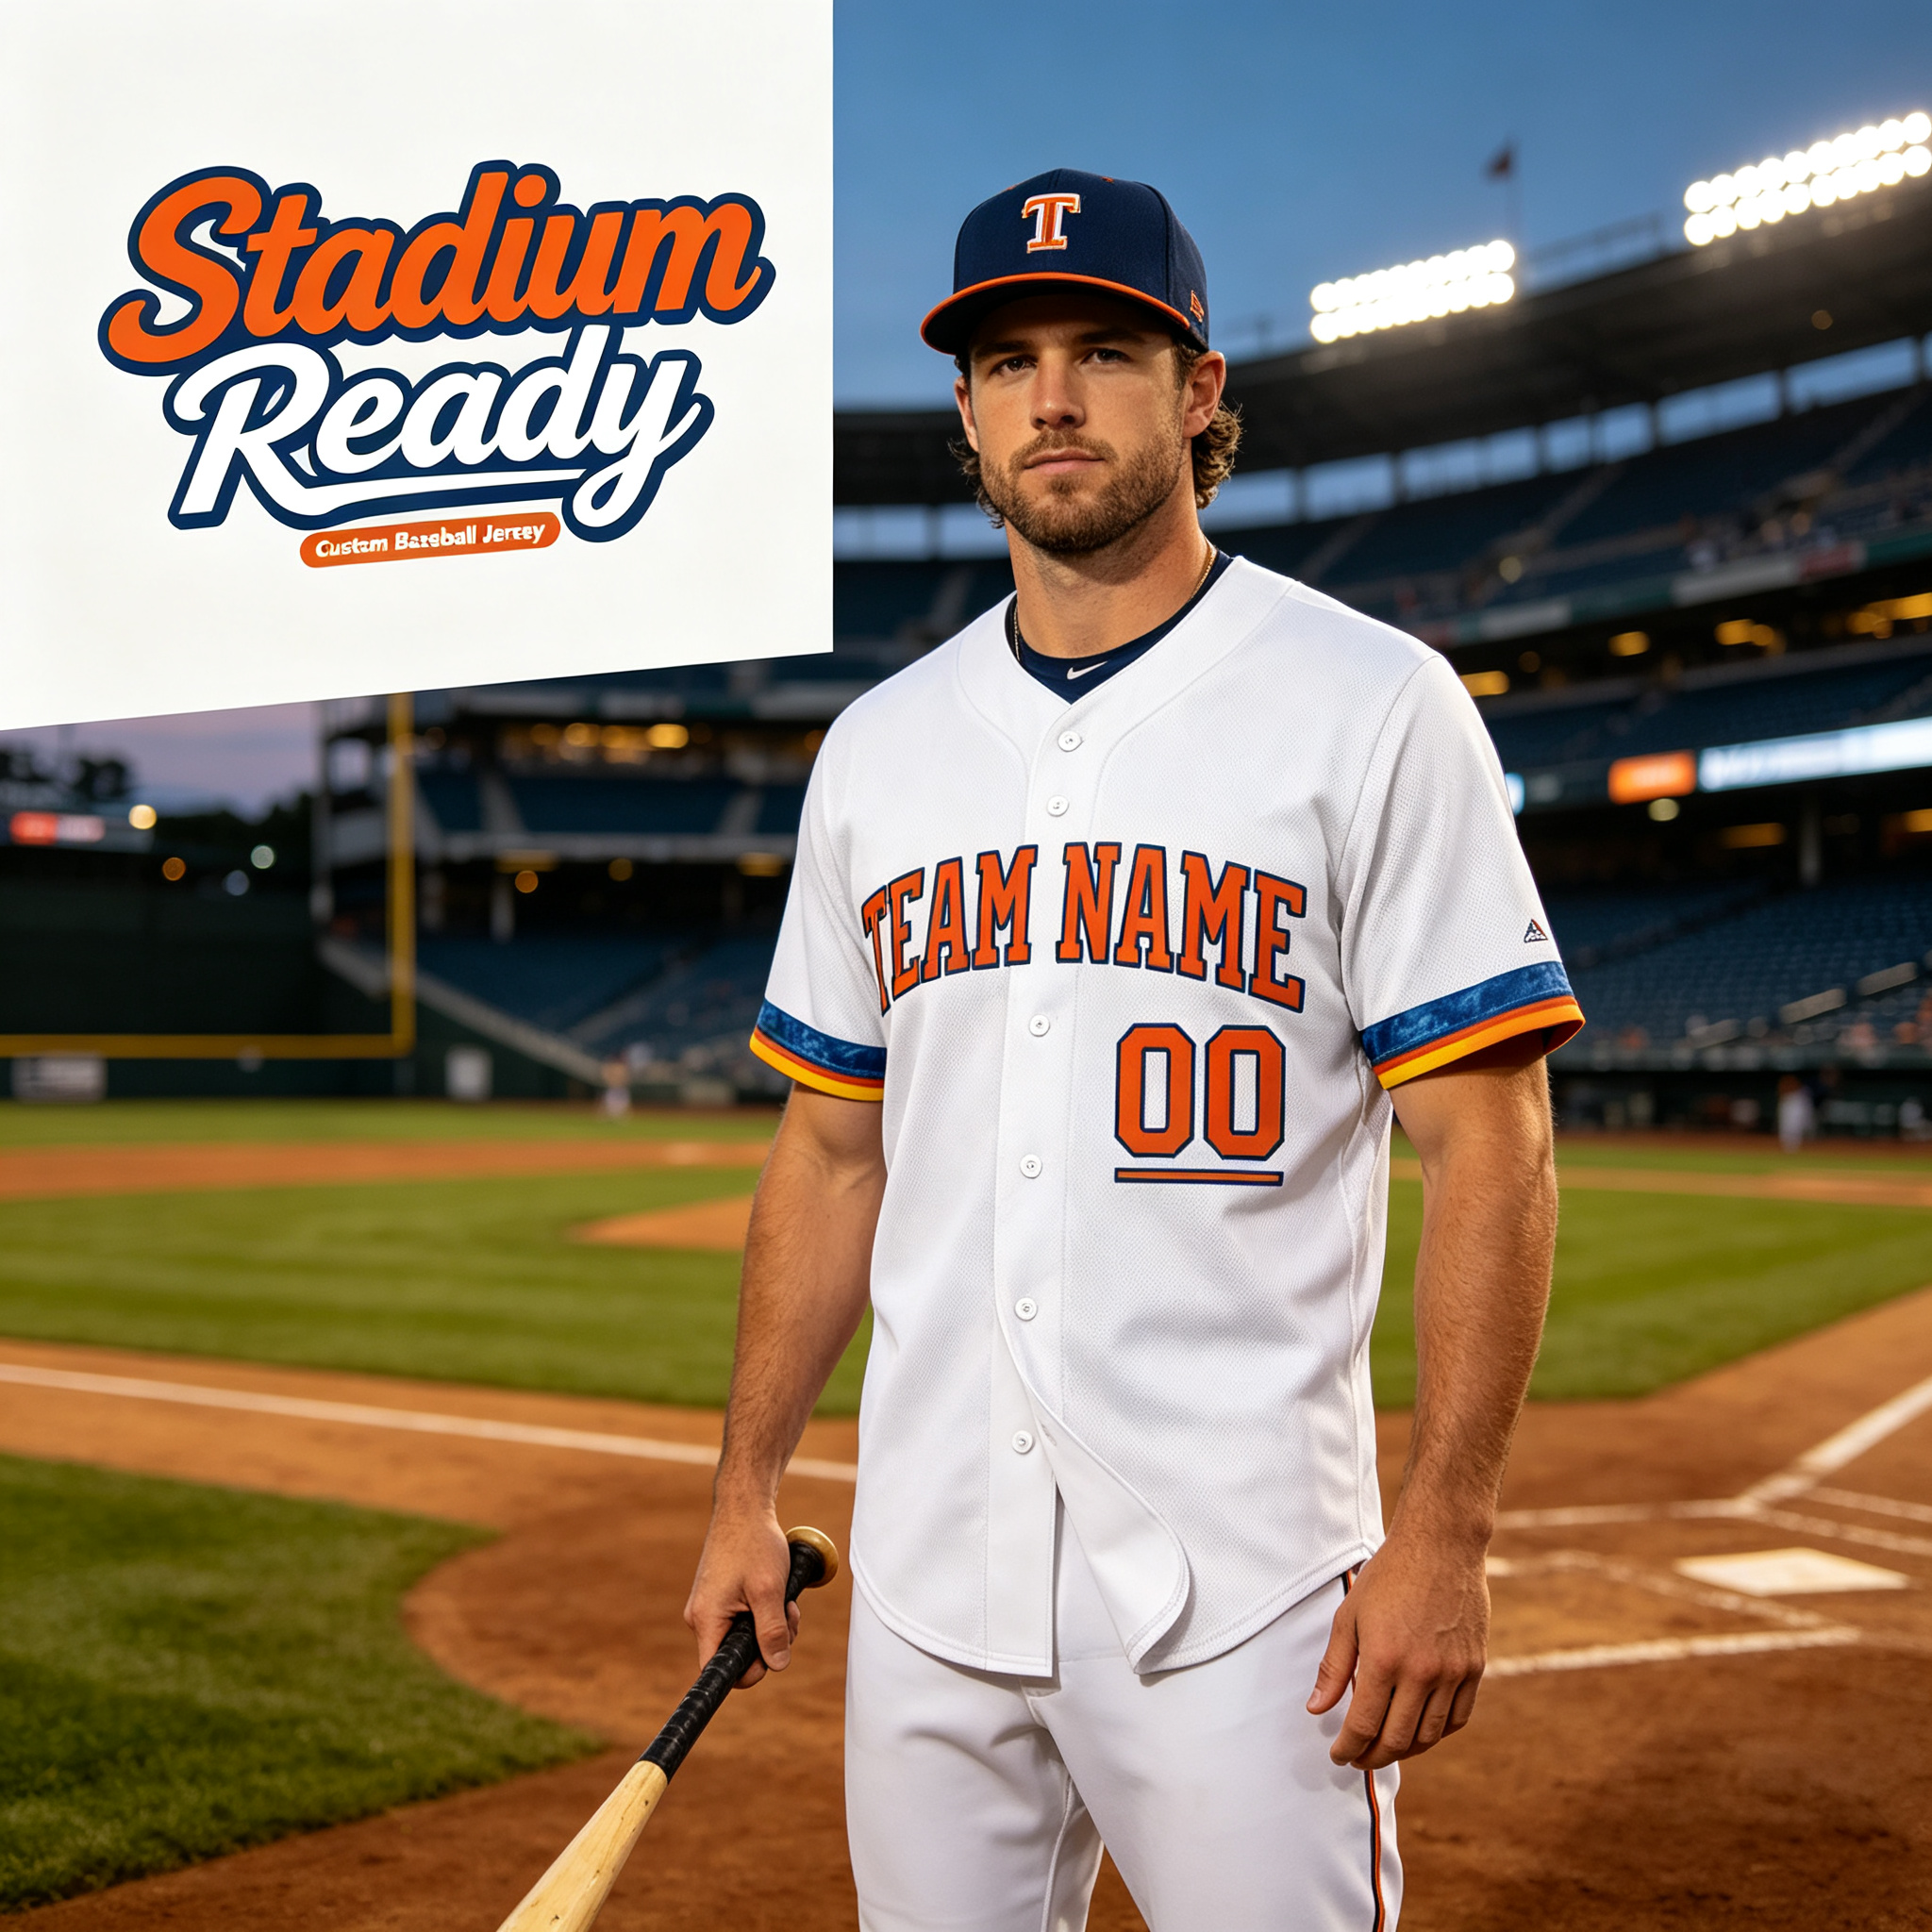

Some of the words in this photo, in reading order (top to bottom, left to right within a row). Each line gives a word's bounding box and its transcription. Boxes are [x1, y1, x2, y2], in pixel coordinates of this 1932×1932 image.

[1021, 192, 1081, 254] T
[861, 844, 1039, 1018] TEAM
[1055, 841, 1308, 1014] NAME
[1114, 1022, 1287, 1161] 00
